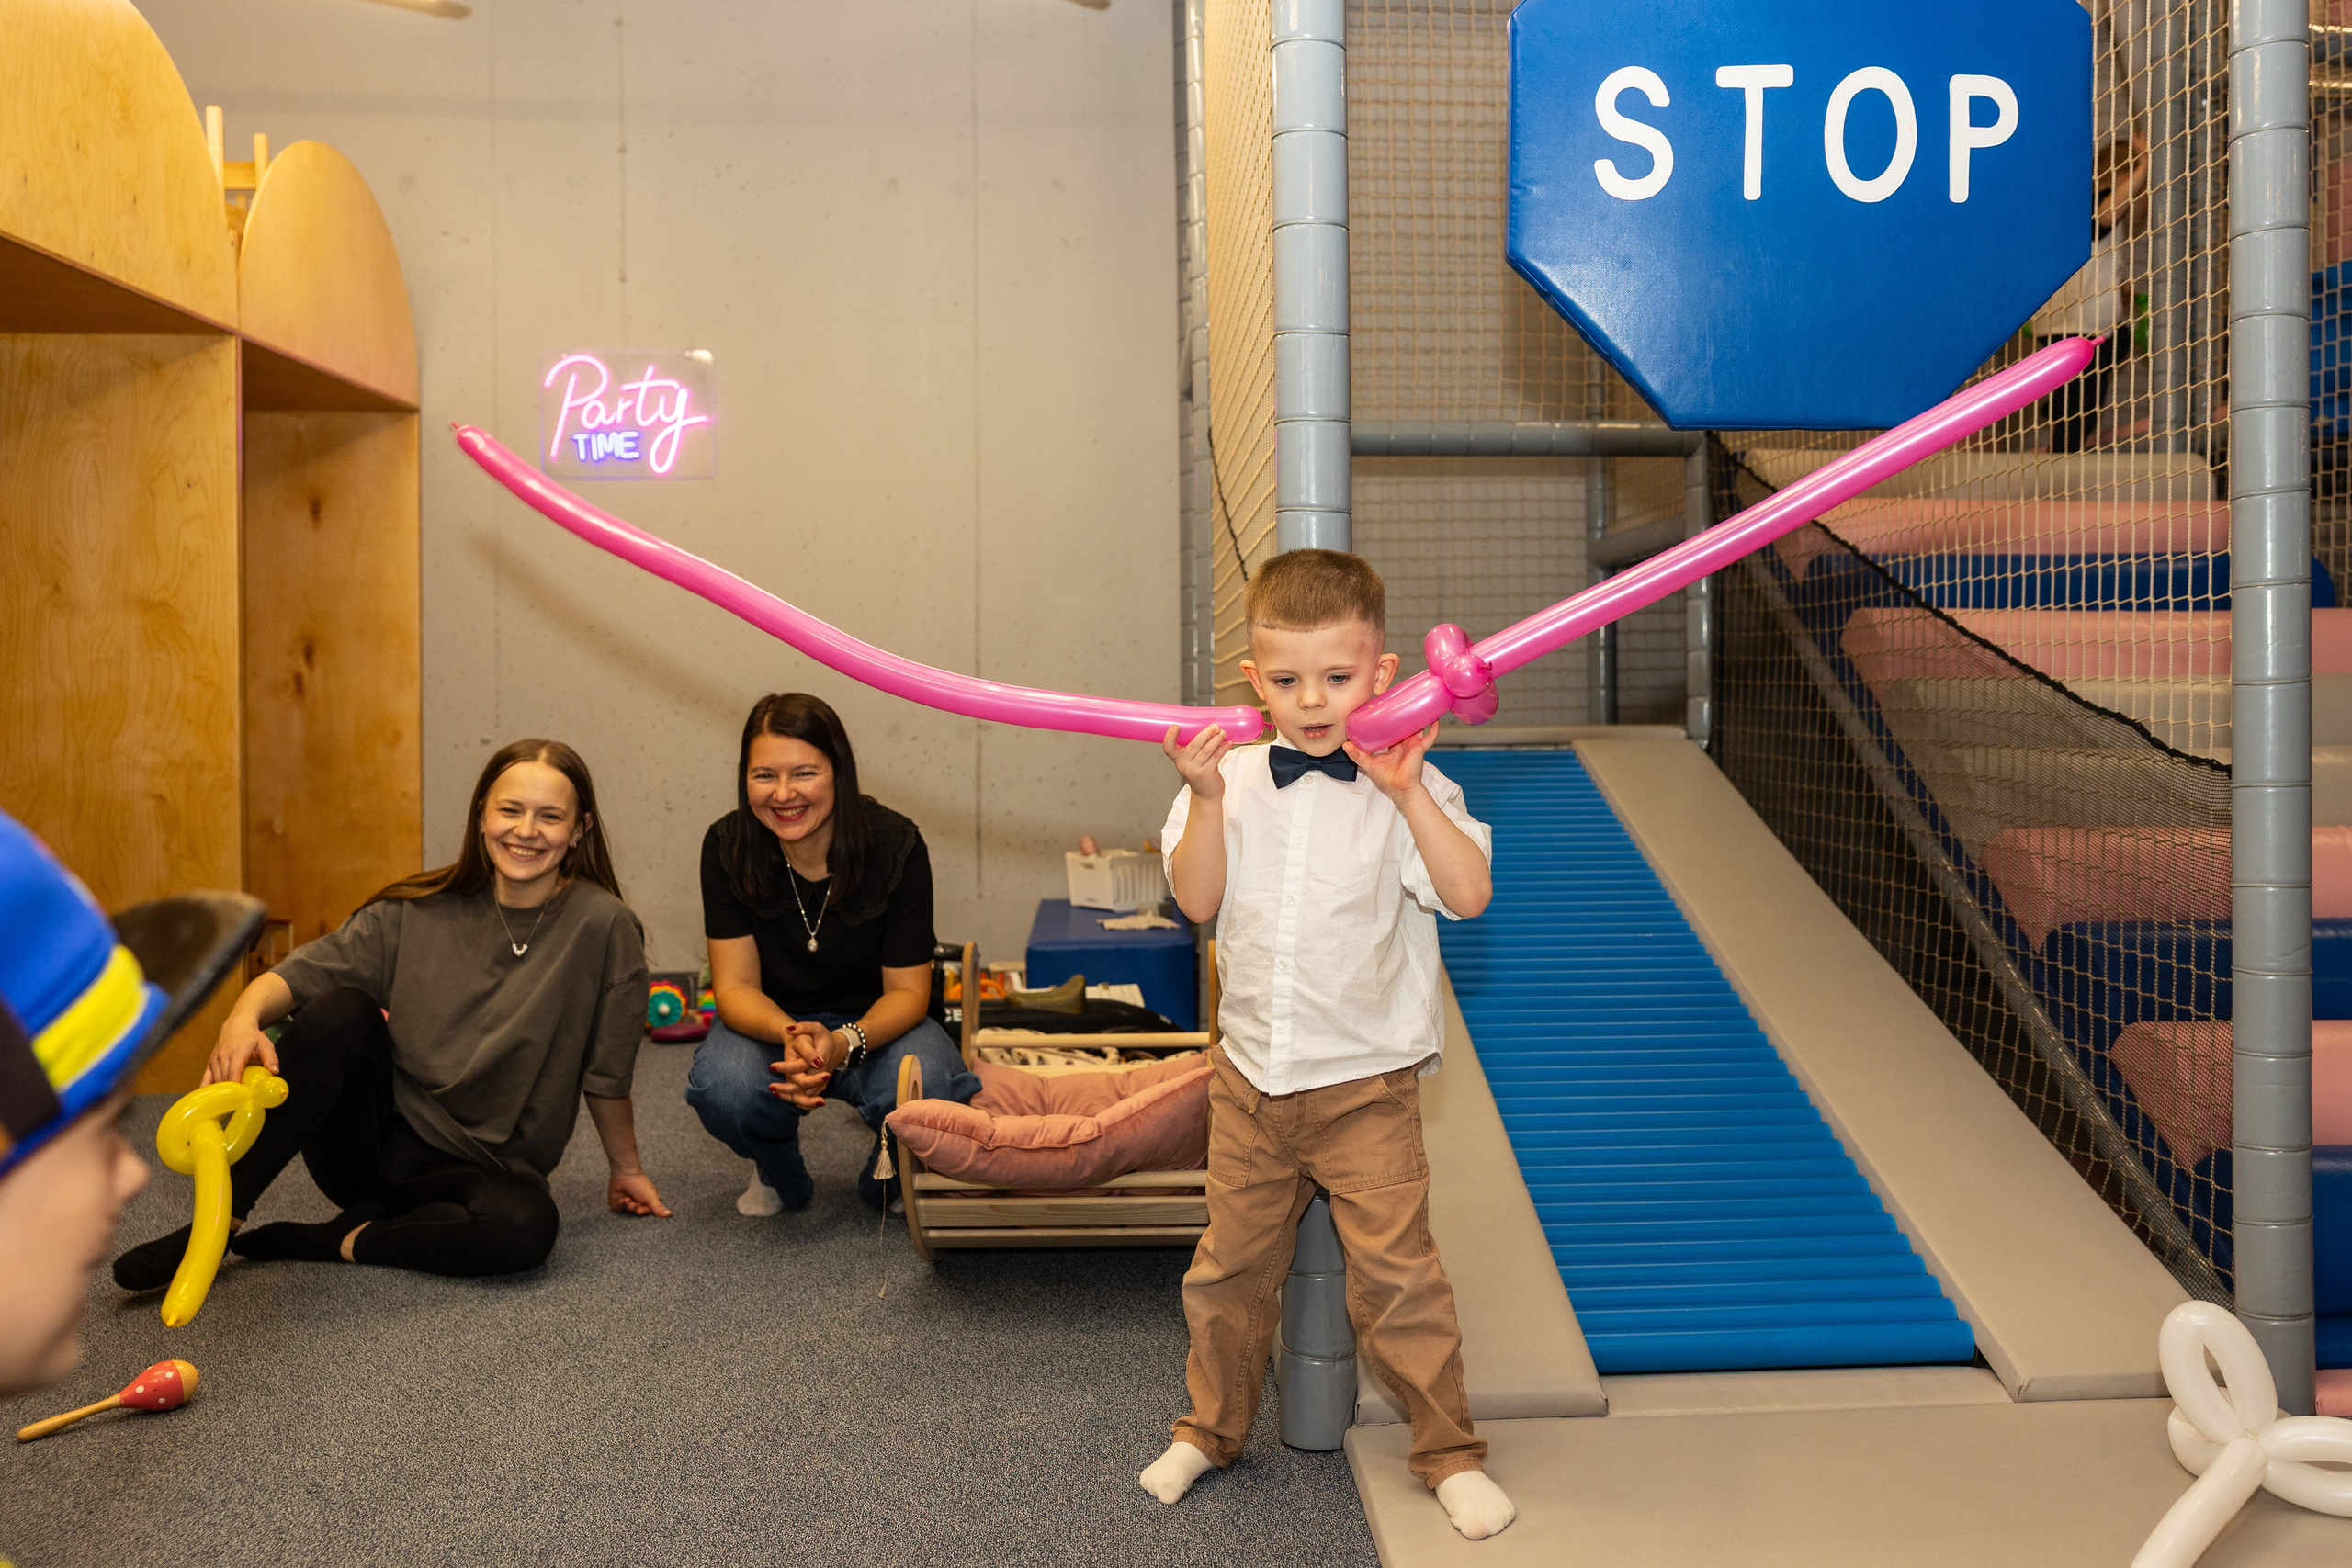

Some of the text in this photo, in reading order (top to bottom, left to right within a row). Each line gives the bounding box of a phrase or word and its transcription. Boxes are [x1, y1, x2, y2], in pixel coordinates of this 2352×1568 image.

[1594, 64, 2019, 203] STOP
[543, 354, 708, 474] Party
[571, 430, 641, 462] TIME
